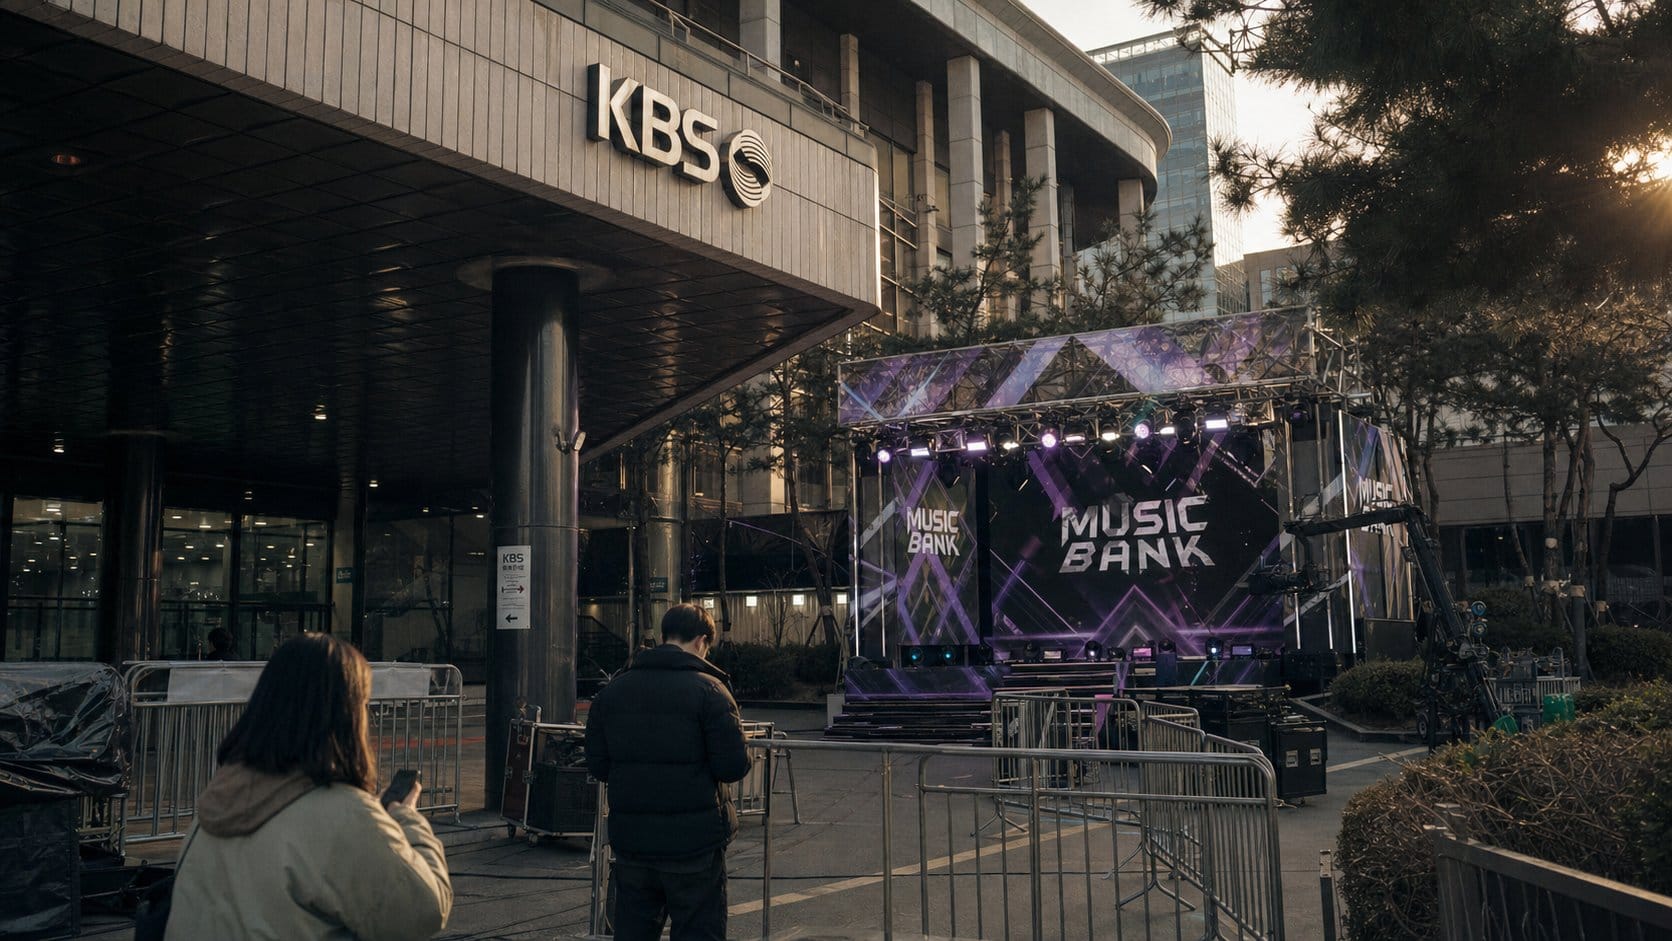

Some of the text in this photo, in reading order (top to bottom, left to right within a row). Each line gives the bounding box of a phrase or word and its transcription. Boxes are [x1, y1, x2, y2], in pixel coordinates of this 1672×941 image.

[588, 63, 720, 183] KBS
[907, 506, 960, 535] MUSIC
[1061, 495, 1208, 547] MUSIC
[502, 553, 524, 563] KBS
[907, 531, 960, 556] BANK
[1059, 535, 1215, 575] BANK
